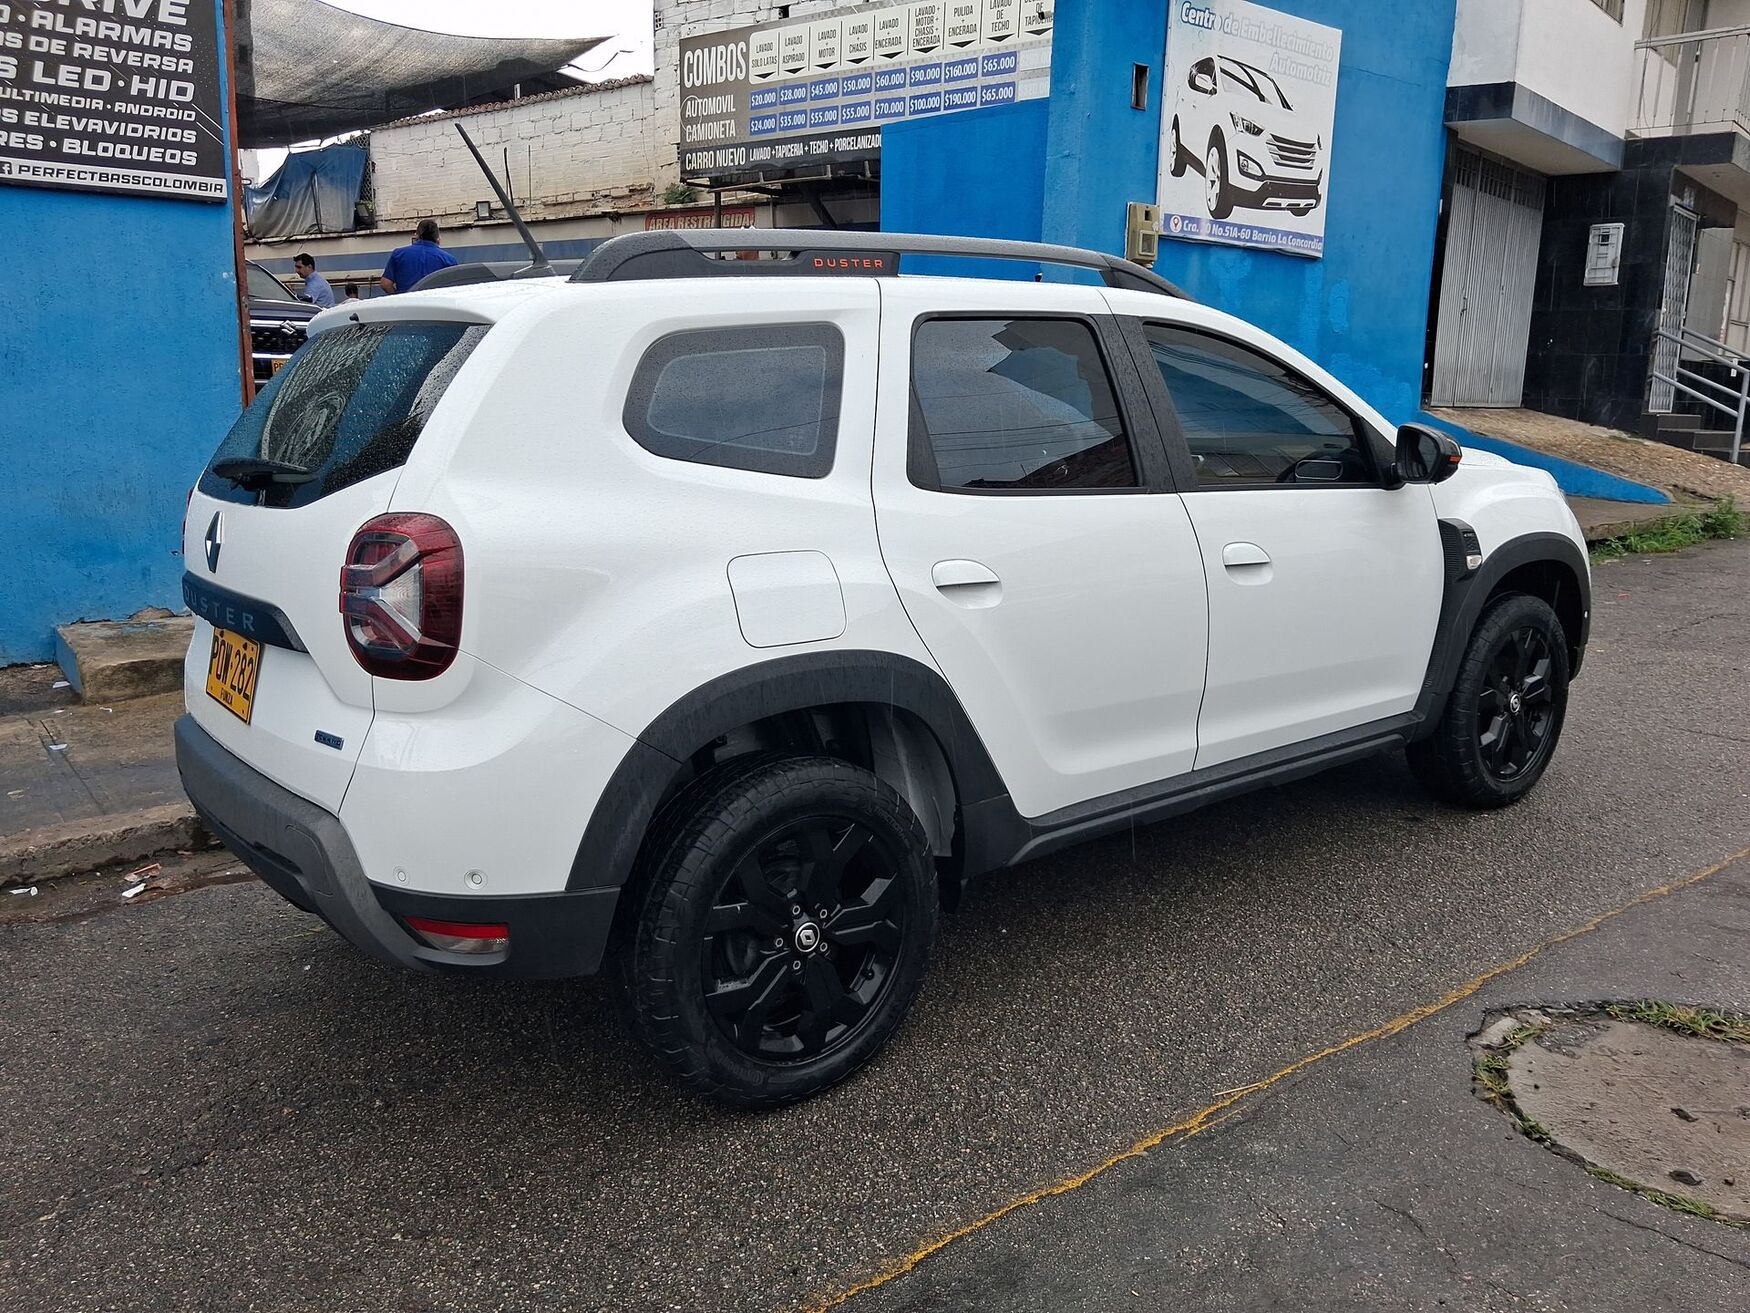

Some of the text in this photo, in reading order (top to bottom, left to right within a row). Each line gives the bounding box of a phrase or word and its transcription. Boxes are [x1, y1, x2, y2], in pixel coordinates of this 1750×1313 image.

[914, 5, 936, 17] LAVADO
[953, 5, 974, 17] PULIDA
[996, 9, 1004, 20] DE
[879, 17, 899, 31] LAVADO
[915, 15, 935, 27] MOTOR
[991, 20, 1010, 33] TECHO
[31, 10, 194, 52] ALARMAS
[817, 29, 837, 41] LAVADO
[848, 23, 868, 36] LAVADO
[914, 26, 935, 37] CHASIS
[948, 23, 978, 38] ENCERADA
[1223, 11, 1240, 37] de
[1238, 17, 1335, 63] Embellecimiento
[755, 41, 774, 54] LAVADO
[784, 35, 803, 47] LAVADO
[848, 42, 867, 54] CHASIS
[874, 36, 902, 50] ENCERADA
[912, 35, 941, 48] ENCERADA
[0, 31, 194, 74] S DE REVERSA
[782, 52, 806, 65] ASPIRADO
[818, 47, 836, 58] MOTOR
[683, 41, 748, 88] COMBOS
[751, 55, 778, 69] SOLO LATAS
[1268, 51, 1333, 87] Automotriz
[33, 60, 112, 92] LED
[129, 75, 196, 103] HID
[751, 55, 1015, 107] $20.000 $28.000 $45.000 $50.000 $60.000 $90.000 $160.000 $65.000
[114, 101, 196, 122] ANDROID
[685, 94, 736, 118] AUTOMOVIL
[750, 86, 1014, 132] $24.000 $35.000 $55.000 $55.000 $70.000 $100.000 $190.000 $65.000
[24, 110, 197, 144] ELEVAVIDRIOS
[685, 119, 736, 142] CAMIONETA
[62, 138, 198, 167] BLOQUEOS
[750, 146, 771, 161] LAVADO
[809, 139, 829, 154] TECHO
[834, 133, 882, 152] PORCELANIZAD
[685, 147, 746, 170] CARRO NUEVO
[17, 164, 225, 194] PERFECTBASSCOLOMBIA
[1183, 220, 1199, 232] Cra.
[1211, 224, 1251, 240] No.51A-60
[1252, 230, 1276, 243] Barrio
[1277, 233, 1287, 244] La
[1288, 235, 1323, 250] Concordia
[813, 258, 884, 268] DUSTER
[183, 585, 256, 632] DUSTER
